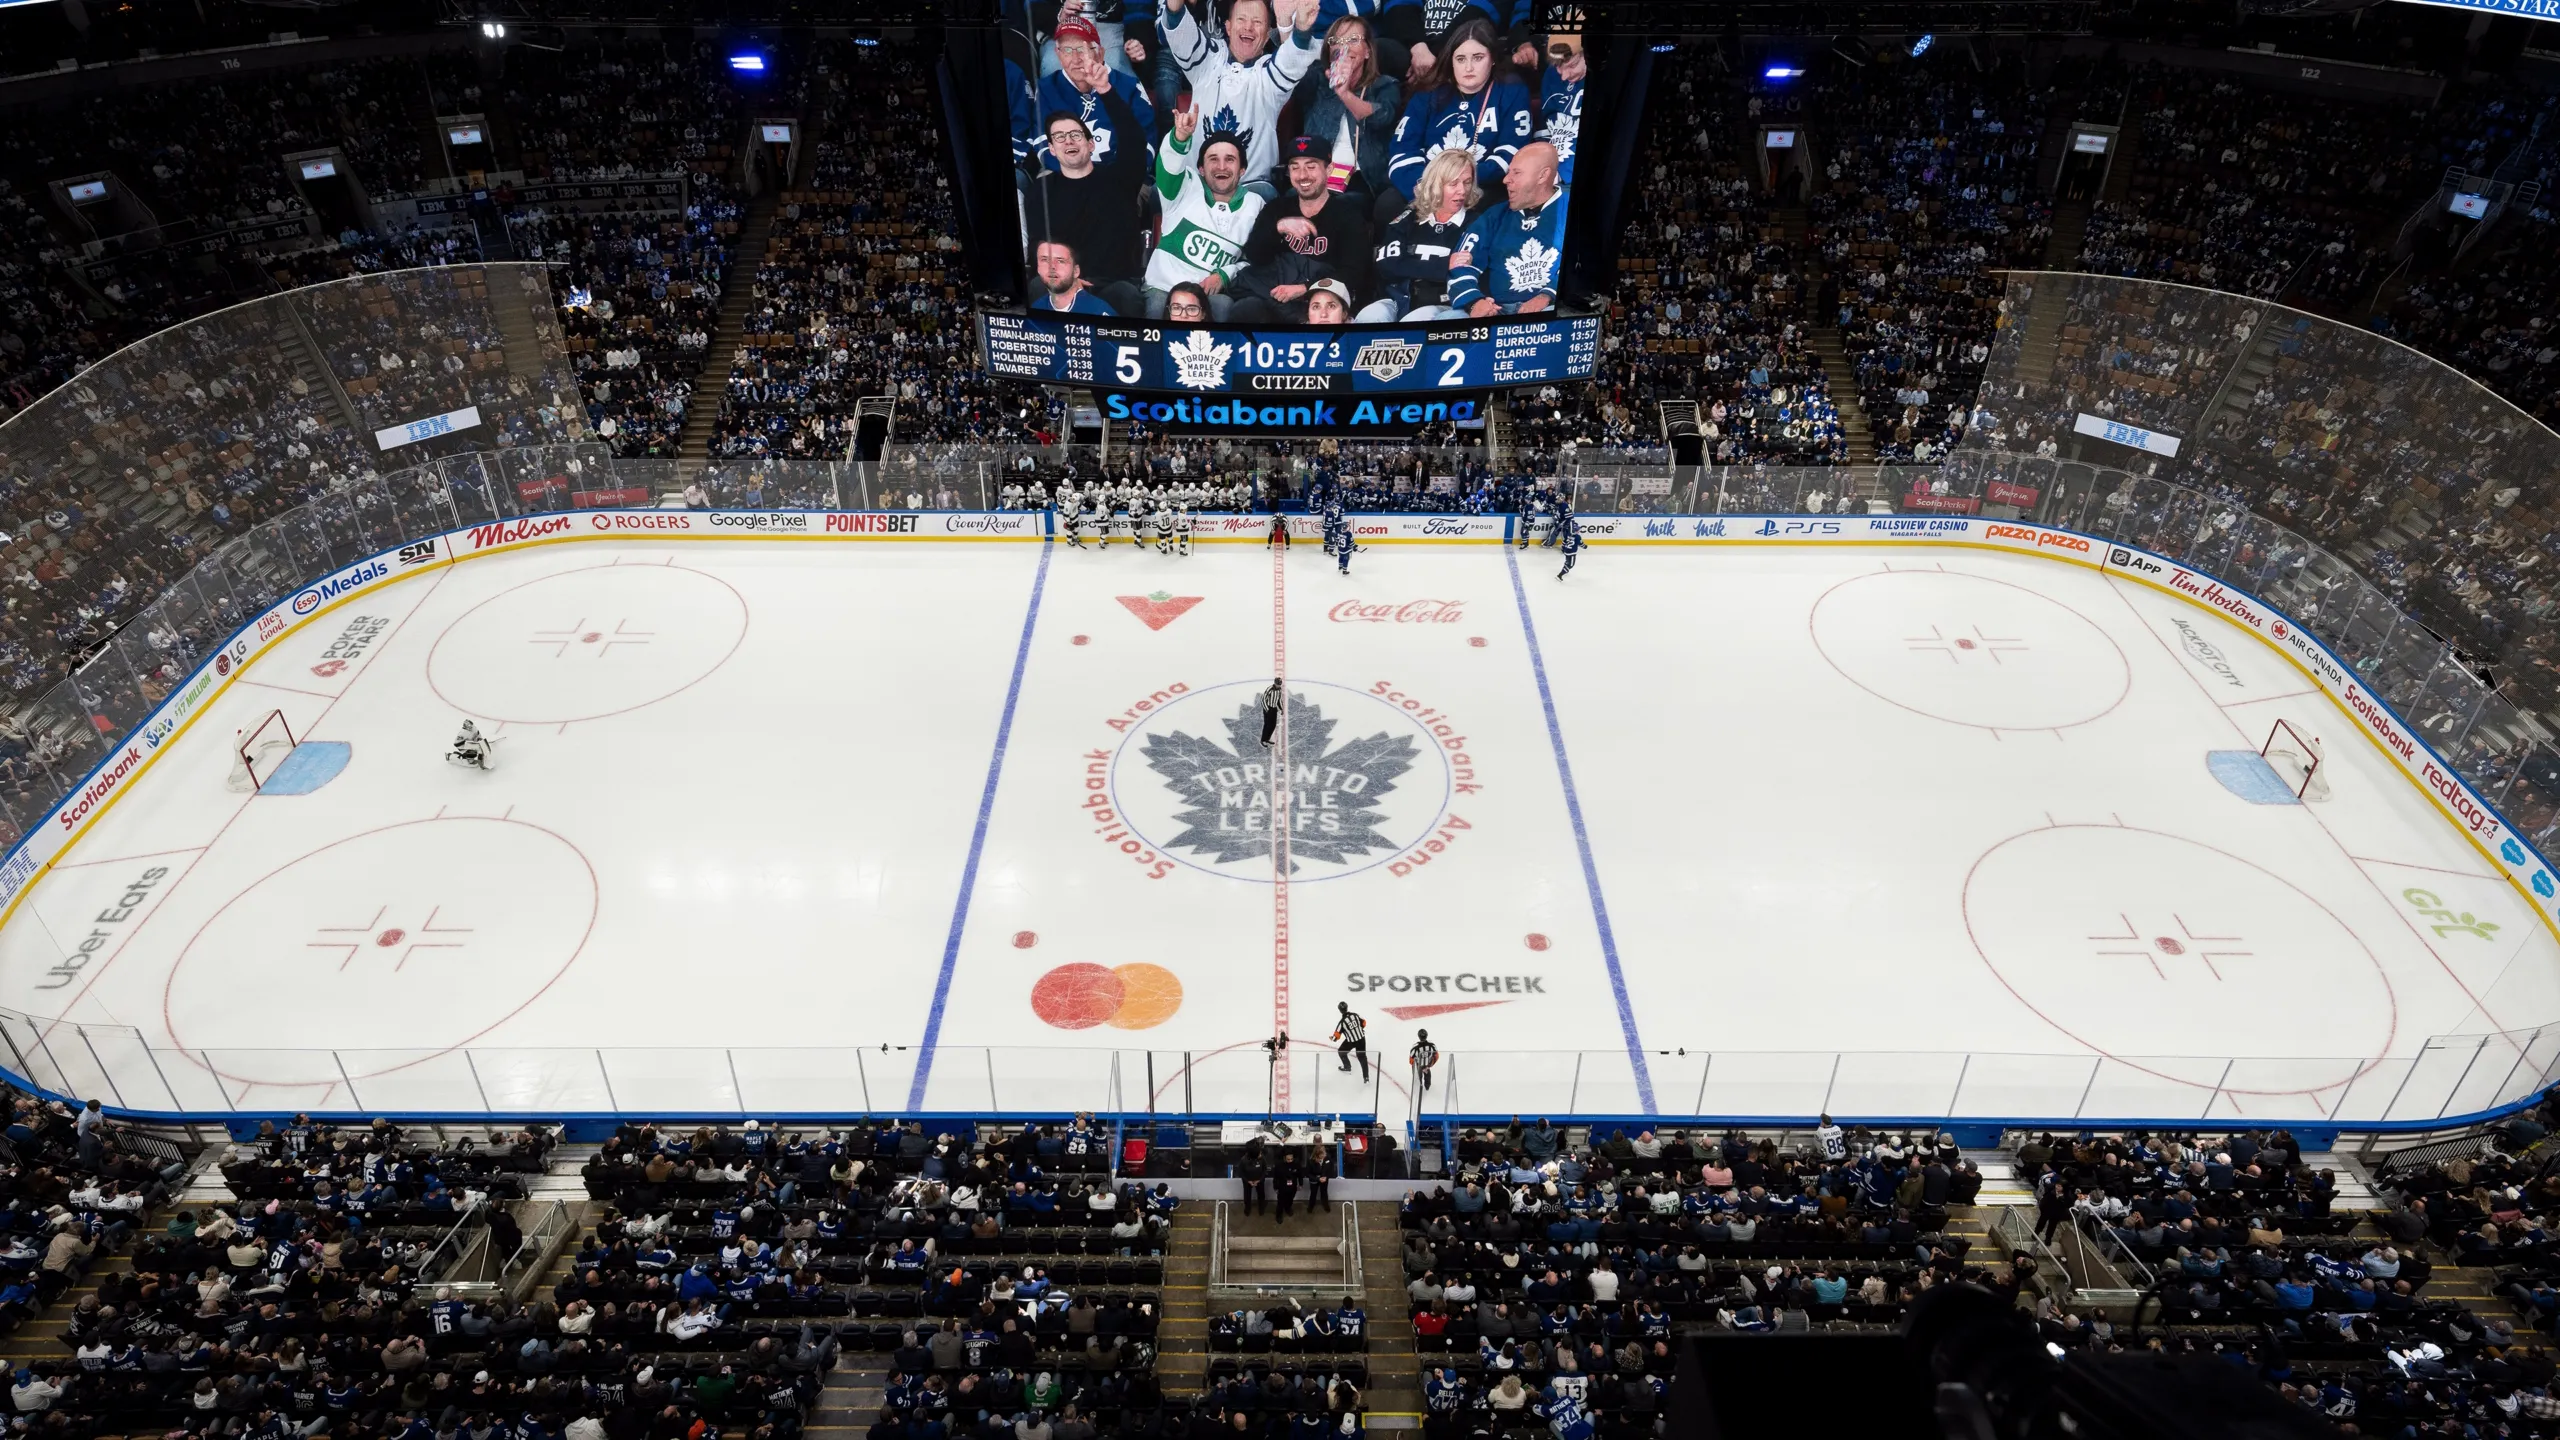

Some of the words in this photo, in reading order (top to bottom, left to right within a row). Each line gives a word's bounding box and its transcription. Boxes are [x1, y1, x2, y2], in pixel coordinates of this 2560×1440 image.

[2503, 0, 2558, 16] STAR
[221, 58, 241, 70] 116
[2301, 68, 2321, 79] 122
[1478, 107, 1498, 133] A
[524, 190, 549, 202] IBM
[558, 187, 584, 200] IBM
[588, 187, 614, 198] IBM
[623, 184, 646, 196] IBM
[655, 183, 679, 196] IBM
[421, 200, 447, 213] IBM
[238, 229, 266, 245] IBM
[275, 223, 301, 237] IBM
[1376, 240, 1401, 262] 16
[1515, 260, 1548, 272] TORONTO
[1519, 268, 1541, 277] MAPLE
[1518, 275, 1543, 284] LEAFS
[989, 316, 1024, 329] RIELLY
[1064, 324, 1091, 335] 17:14
[1428, 331, 1468, 341] SHOTS
[1471, 327, 1489, 340] 33
[1497, 323, 1547, 336] ENGLUND
[1572, 318, 1597, 329] 11:50
[990, 328, 1057, 344] EKMAN-LARSSON
[1065, 336, 1092, 347] 16:56
[1097, 328, 1138, 339] SHOTS
[1143, 328, 1161, 342] 20
[1495, 333, 1562, 348] BURROUGHS
[1570, 330, 1596, 341] 13:57
[991, 340, 1055, 355] ROBERTSON
[1066, 348, 1092, 358] 12:35
[1238, 342, 1325, 369] 10:57
[1329, 344, 1341, 359] 3
[1360, 348, 1416, 366] KINGS
[1495, 348, 1537, 359] CLARKE
[1569, 342, 1594, 352] 16:32
[992, 352, 1051, 366] HOLMBERG
[1066, 359, 1093, 370] 13:38
[1115, 345, 1142, 384] 5
[1181, 353, 1221, 366] TORONTO
[1188, 363, 1214, 372] MAPLE
[1438, 348, 1466, 386] 2
[1493, 361, 1514, 371] LEE
[1567, 353, 1593, 364] 07:42
[993, 362, 1038, 375] TAVARES
[1067, 370, 1094, 381] 14:22
[1188, 370, 1215, 379] LEAFS
[1493, 368, 1547, 382] TURCOTTE
[1566, 363, 1592, 375] 10:17
[1252, 375, 1331, 390] CITIZEN
[1106, 394, 1337, 426] Scotiabank
[1350, 400, 1475, 425] Arena
[406, 414, 451, 441] IBM
[2103, 421, 2149, 449] IBM
[1916, 498, 1942, 508] Scotia
[1943, 501, 1966, 509] Perks
[615, 515, 690, 530] ROGERS
[709, 513, 768, 533] Google
[771, 513, 807, 527] Pixel
[826, 514, 919, 533] POINTSBET
[946, 514, 985, 532] Crown
[981, 514, 1024, 533] Royal
[1222, 517, 1265, 533] Molson
[1422, 517, 1468, 535] Ford
[1579, 524, 1615, 534] cene
[1643, 518, 1677, 537] Milk
[1693, 518, 1727, 537] Milk
[1785, 522, 1841, 534] PS5
[1869, 520, 1927, 532] FALLSVIEW
[1929, 520, 1969, 532] CASINO
[467, 515, 572, 549] Molson
[1985, 524, 2036, 542] pizza
[2037, 532, 2090, 553] pizza
[399, 540, 436, 563] SN
[320, 561, 389, 600] Medals
[296, 594, 318, 611] Esso
[2169, 567, 2200, 596] Tim
[2201, 582, 2263, 628] Hortons
[1327, 599, 1465, 623] Coca-Cola
[257, 611, 281, 632] Life's
[259, 622, 288, 642] Good.
[320, 615, 374, 660] POKER
[342, 617, 391, 659] STARS
[229, 640, 248, 663] LG
[2170, 618, 2220, 663] JACKPOT
[2213, 661, 2244, 688] CITY
[2288, 634, 2306, 652] AIR
[2306, 647, 2343, 686] CANADA
[175, 702, 187, 718] $17
[185, 672, 212, 706] MILLION
[1105, 681, 1190, 734] Arena
[2344, 683, 2415, 763] Scotiabank
[1369, 680, 1484, 794] Scotiabank
[60, 747, 142, 831] Scotiabank
[2421, 761, 2495, 840] redtag.ca
[1081, 748, 1175, 880] Scotiabank
[1387, 813, 1472, 878] Arena
[34, 929, 113, 990] Uber
[94, 867, 169, 923] Eats
[1348, 1020, 1358, 1030] 20
[291, 1136, 306, 1151] 11
[1067, 1143, 1087, 1154] 29
[1826, 1137, 1844, 1155] 88
[713, 1224, 733, 1238] 34
[269, 1253, 285, 1270] 91
[224, 1320, 248, 1331] TORONTO
[433, 1314, 451, 1334] 16
[1341, 1324, 1360, 1335] 34
[969, 1348, 981, 1366] 8
[1564, 1385, 1582, 1400] 13
[1554, 1409, 1582, 1432] 34
